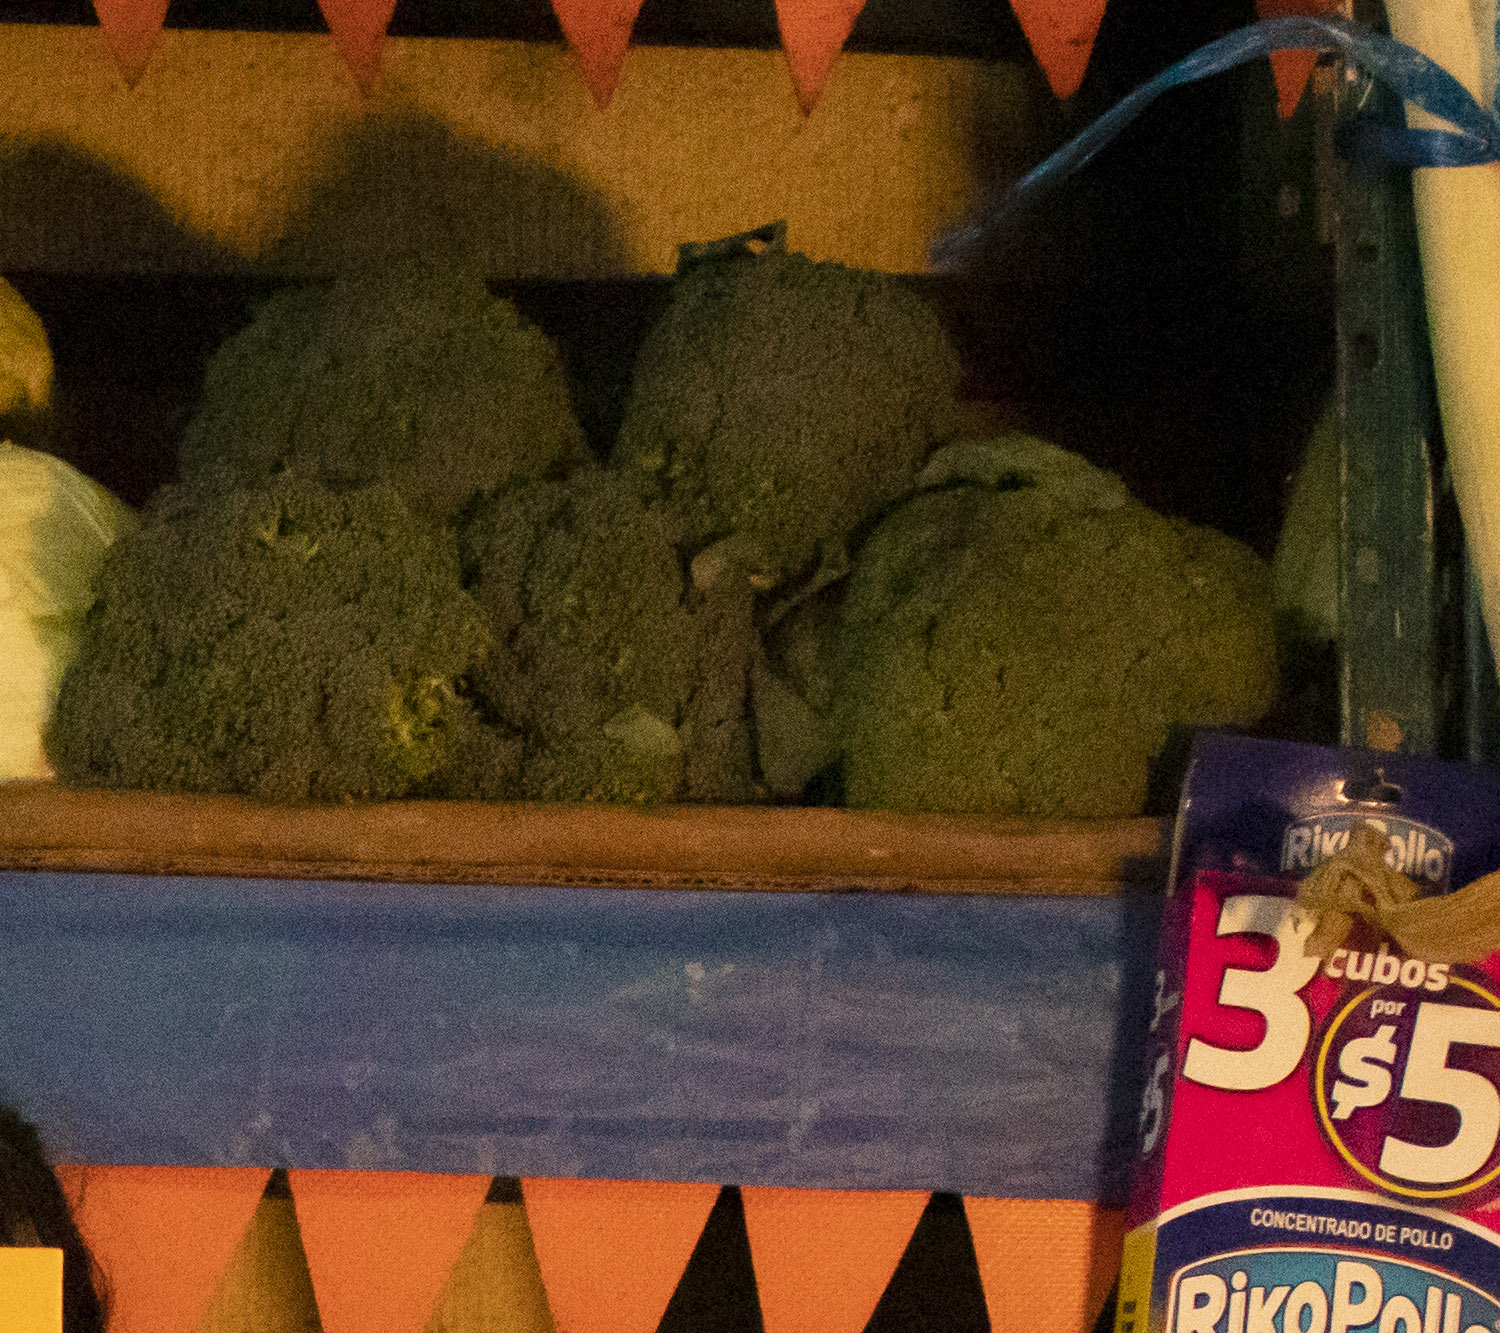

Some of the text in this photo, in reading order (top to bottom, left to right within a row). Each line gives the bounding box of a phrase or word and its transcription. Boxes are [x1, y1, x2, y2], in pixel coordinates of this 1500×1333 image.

[1183, 896, 1320, 1091] 3
[1325, 947, 1452, 991] cubos
[1371, 998, 1406, 1019] por
[1250, 1208, 1453, 1251] CONCENTRADO DE POLLO
